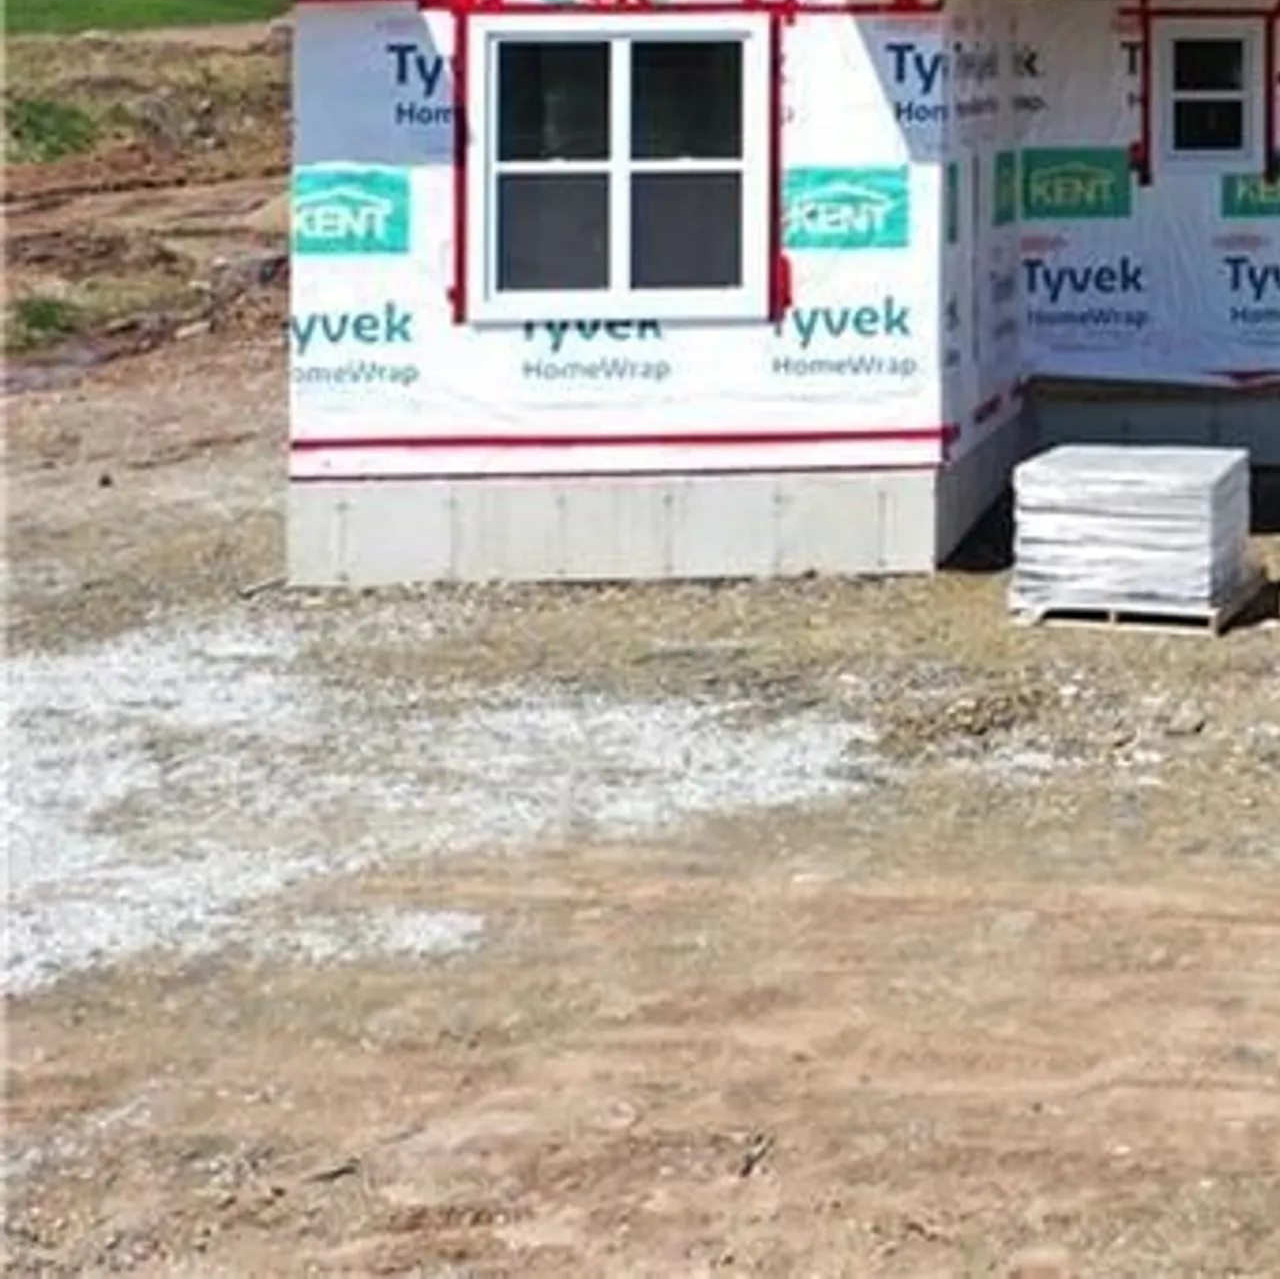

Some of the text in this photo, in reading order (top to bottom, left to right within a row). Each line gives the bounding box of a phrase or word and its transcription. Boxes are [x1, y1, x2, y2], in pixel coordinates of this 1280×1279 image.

[386, 43, 443, 99] Ty
[886, 42, 943, 95] Ty
[1030, 174, 1112, 205] KENT
[786, 195, 890, 234] KENT
[1022, 257, 1143, 303] Tyvek
[290, 301, 413, 355] yvek
[772, 296, 911, 349] yvek
[293, 360, 420, 387] omeWrap
